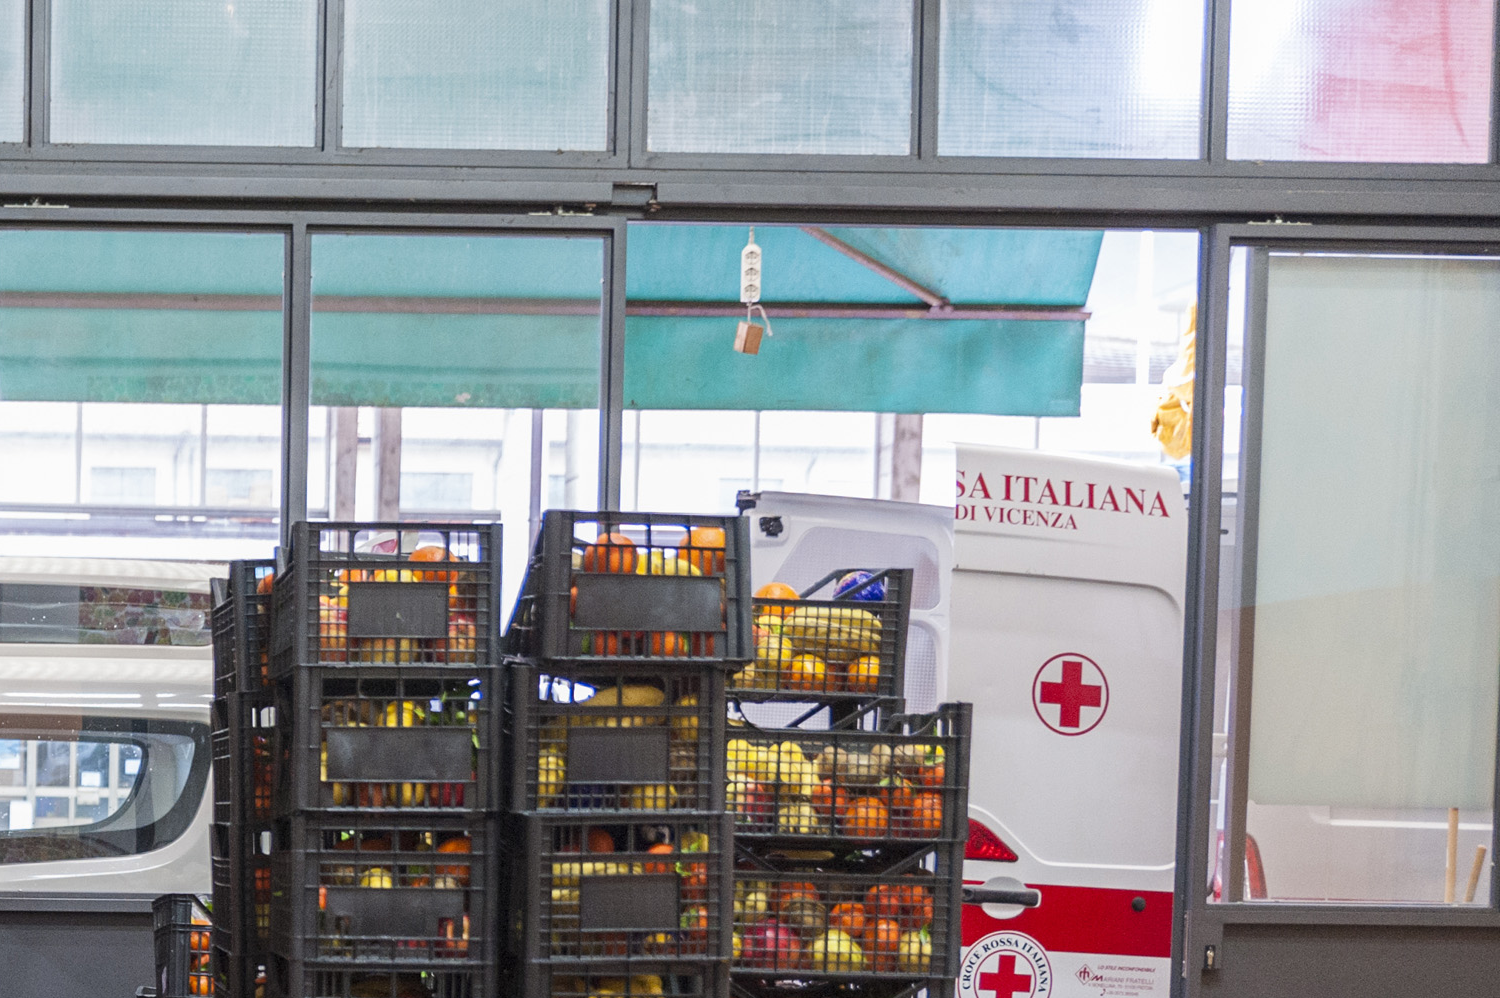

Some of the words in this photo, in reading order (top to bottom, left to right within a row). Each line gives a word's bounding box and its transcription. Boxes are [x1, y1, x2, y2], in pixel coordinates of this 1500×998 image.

[1001, 474, 1171, 518] ITALIANA
[955, 504, 977, 521] DI
[984, 506, 1078, 530] VICENZA
[962, 950, 982, 990] CROCE
[981, 937, 1019, 953] ROSSA
[1021, 942, 1048, 993] ITALIANA
[1125, 976, 1155, 985] FRATELLI
